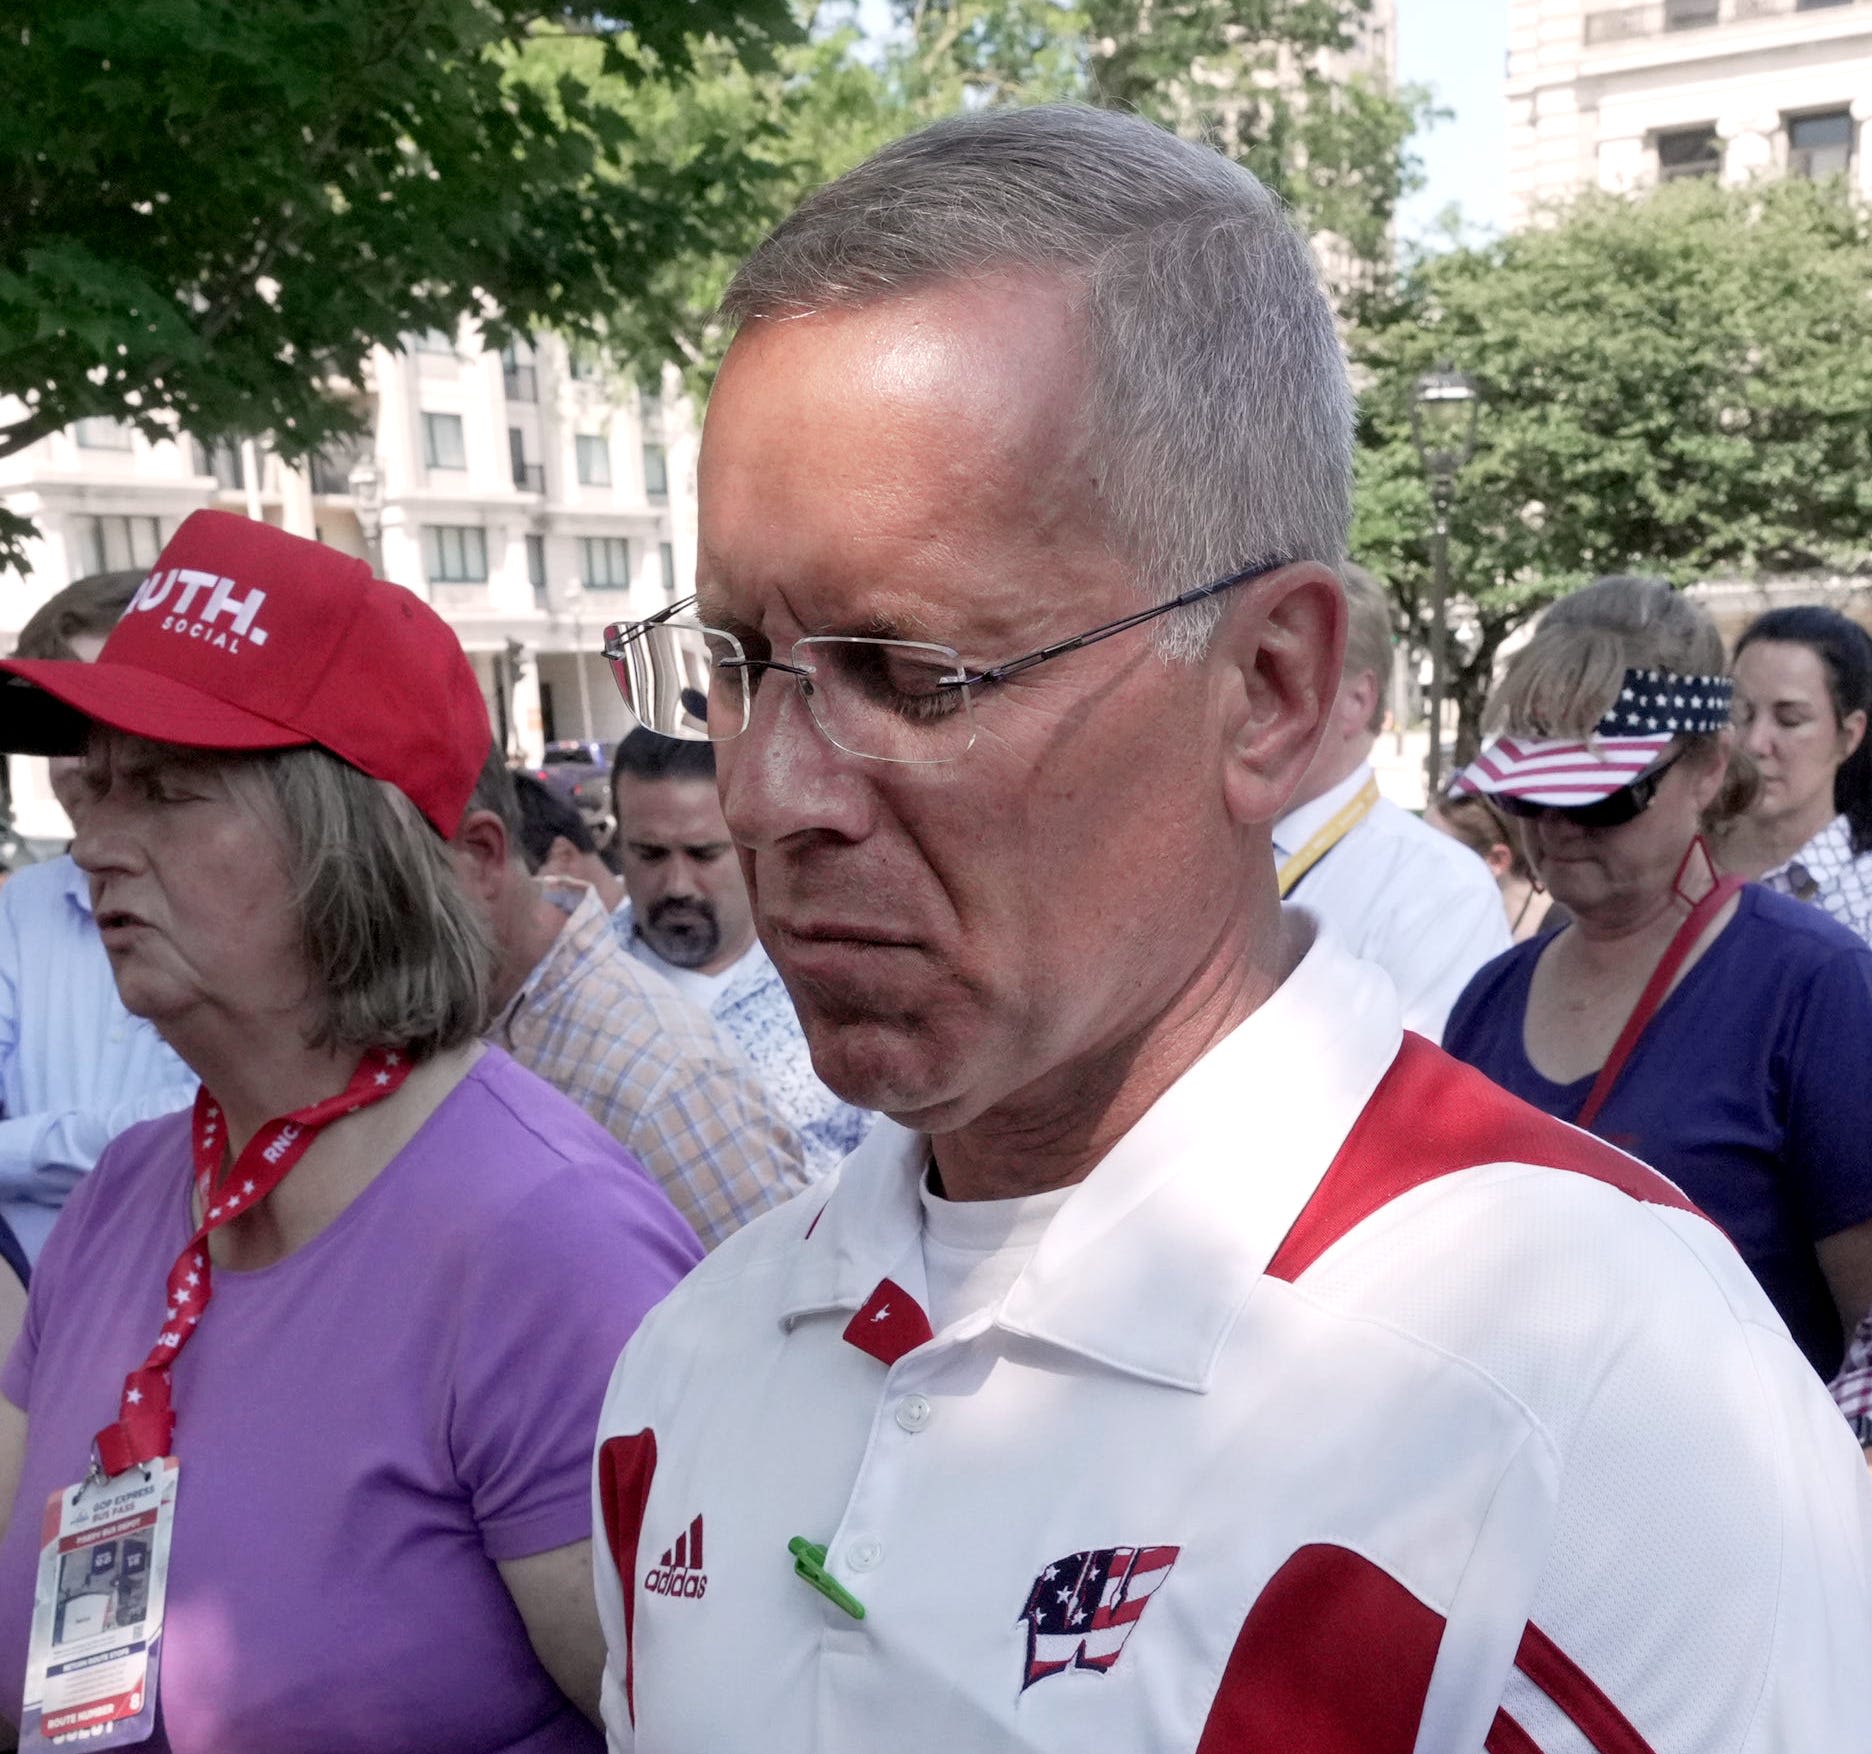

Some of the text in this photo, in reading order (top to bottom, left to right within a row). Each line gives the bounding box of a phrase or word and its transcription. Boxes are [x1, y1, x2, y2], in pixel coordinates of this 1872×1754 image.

[124, 568, 269, 647] UTH.
[161, 615, 240, 655] SOCIAL
[262, 1122, 304, 1165] RNC
[644, 1564, 708, 1600] adidas
[47, 1692, 141, 1730] ROUTE NUMBER 8
